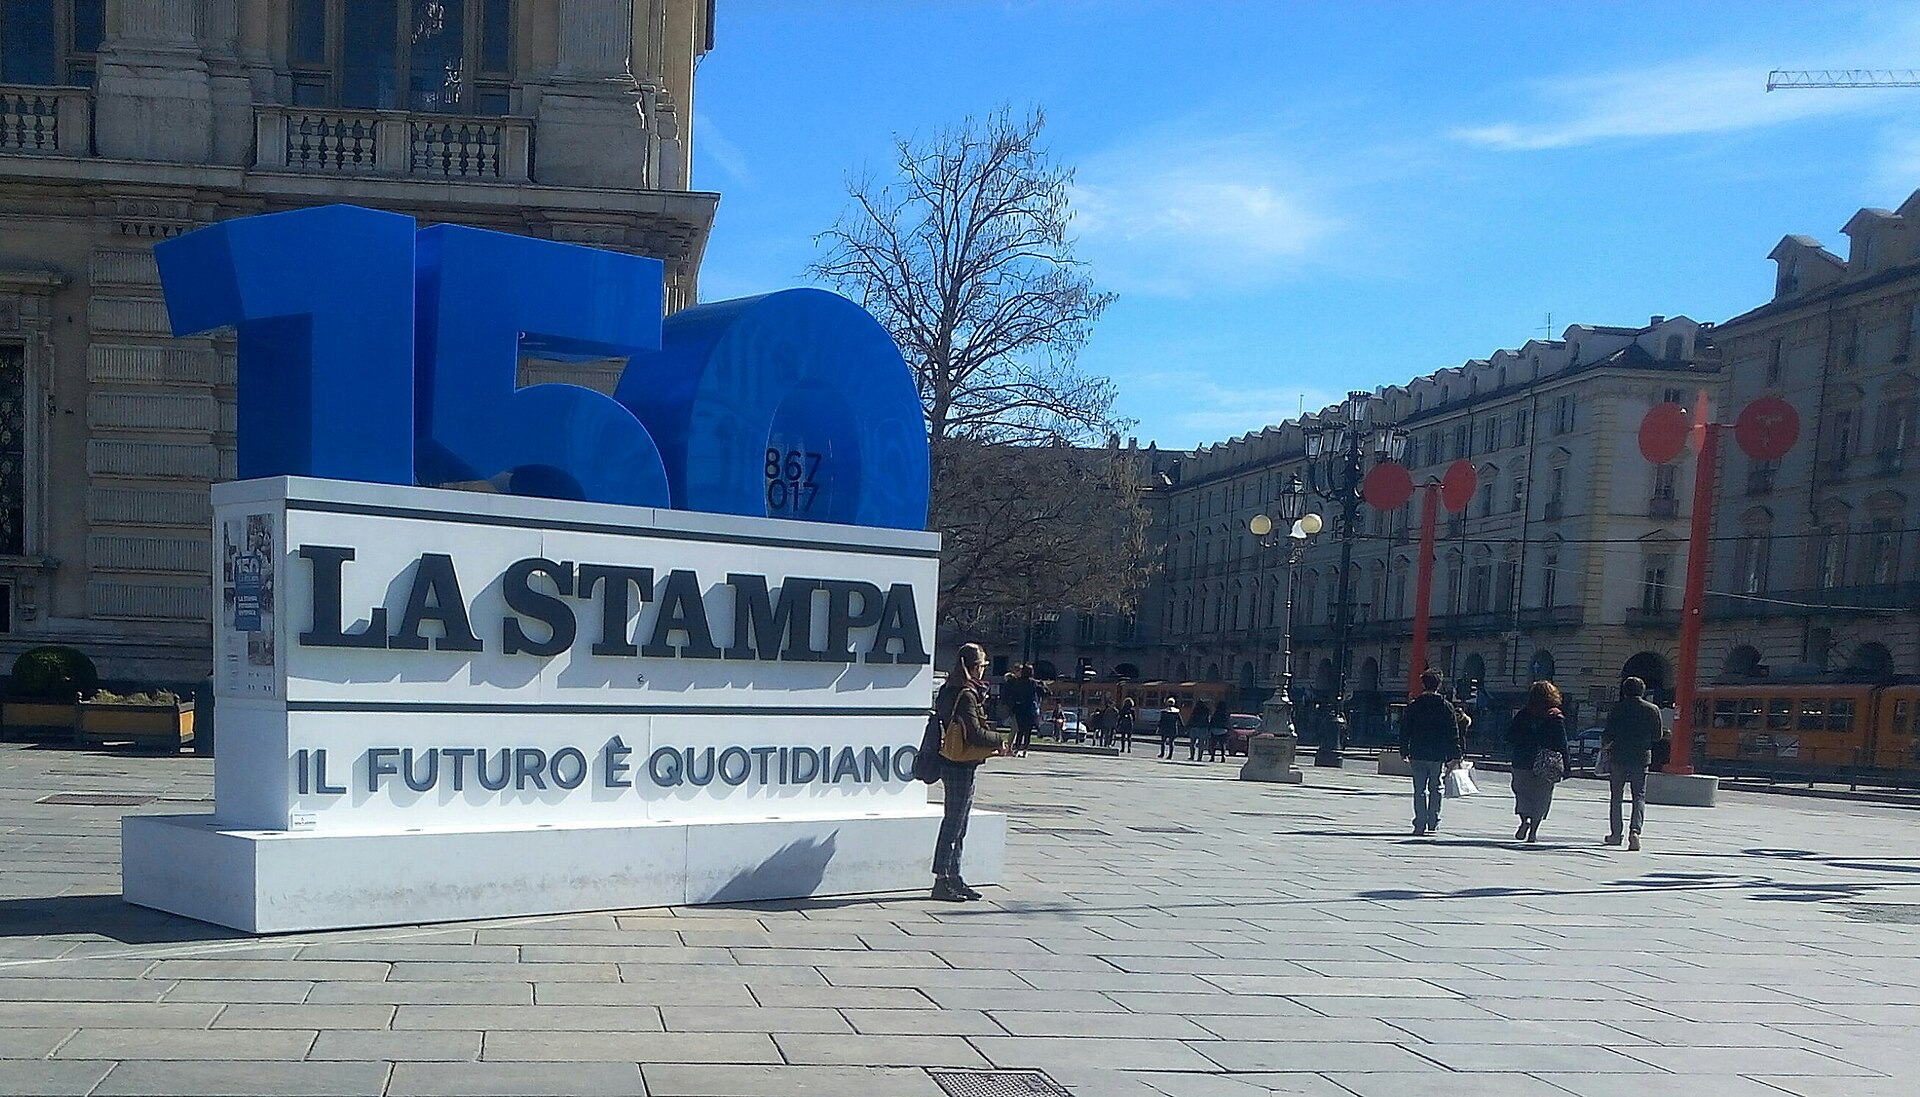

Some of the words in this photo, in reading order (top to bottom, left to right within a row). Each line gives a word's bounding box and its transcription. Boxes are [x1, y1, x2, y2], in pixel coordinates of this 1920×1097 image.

[154, 203, 929, 530] 150
[299, 545, 483, 652] LA
[502, 556, 930, 665] STAMPA
[298, 748, 347, 795] IL
[367, 746, 588, 792] FUTURO
[604, 735, 633, 788] È
[649, 744, 918, 788] QUOTIDIANO
